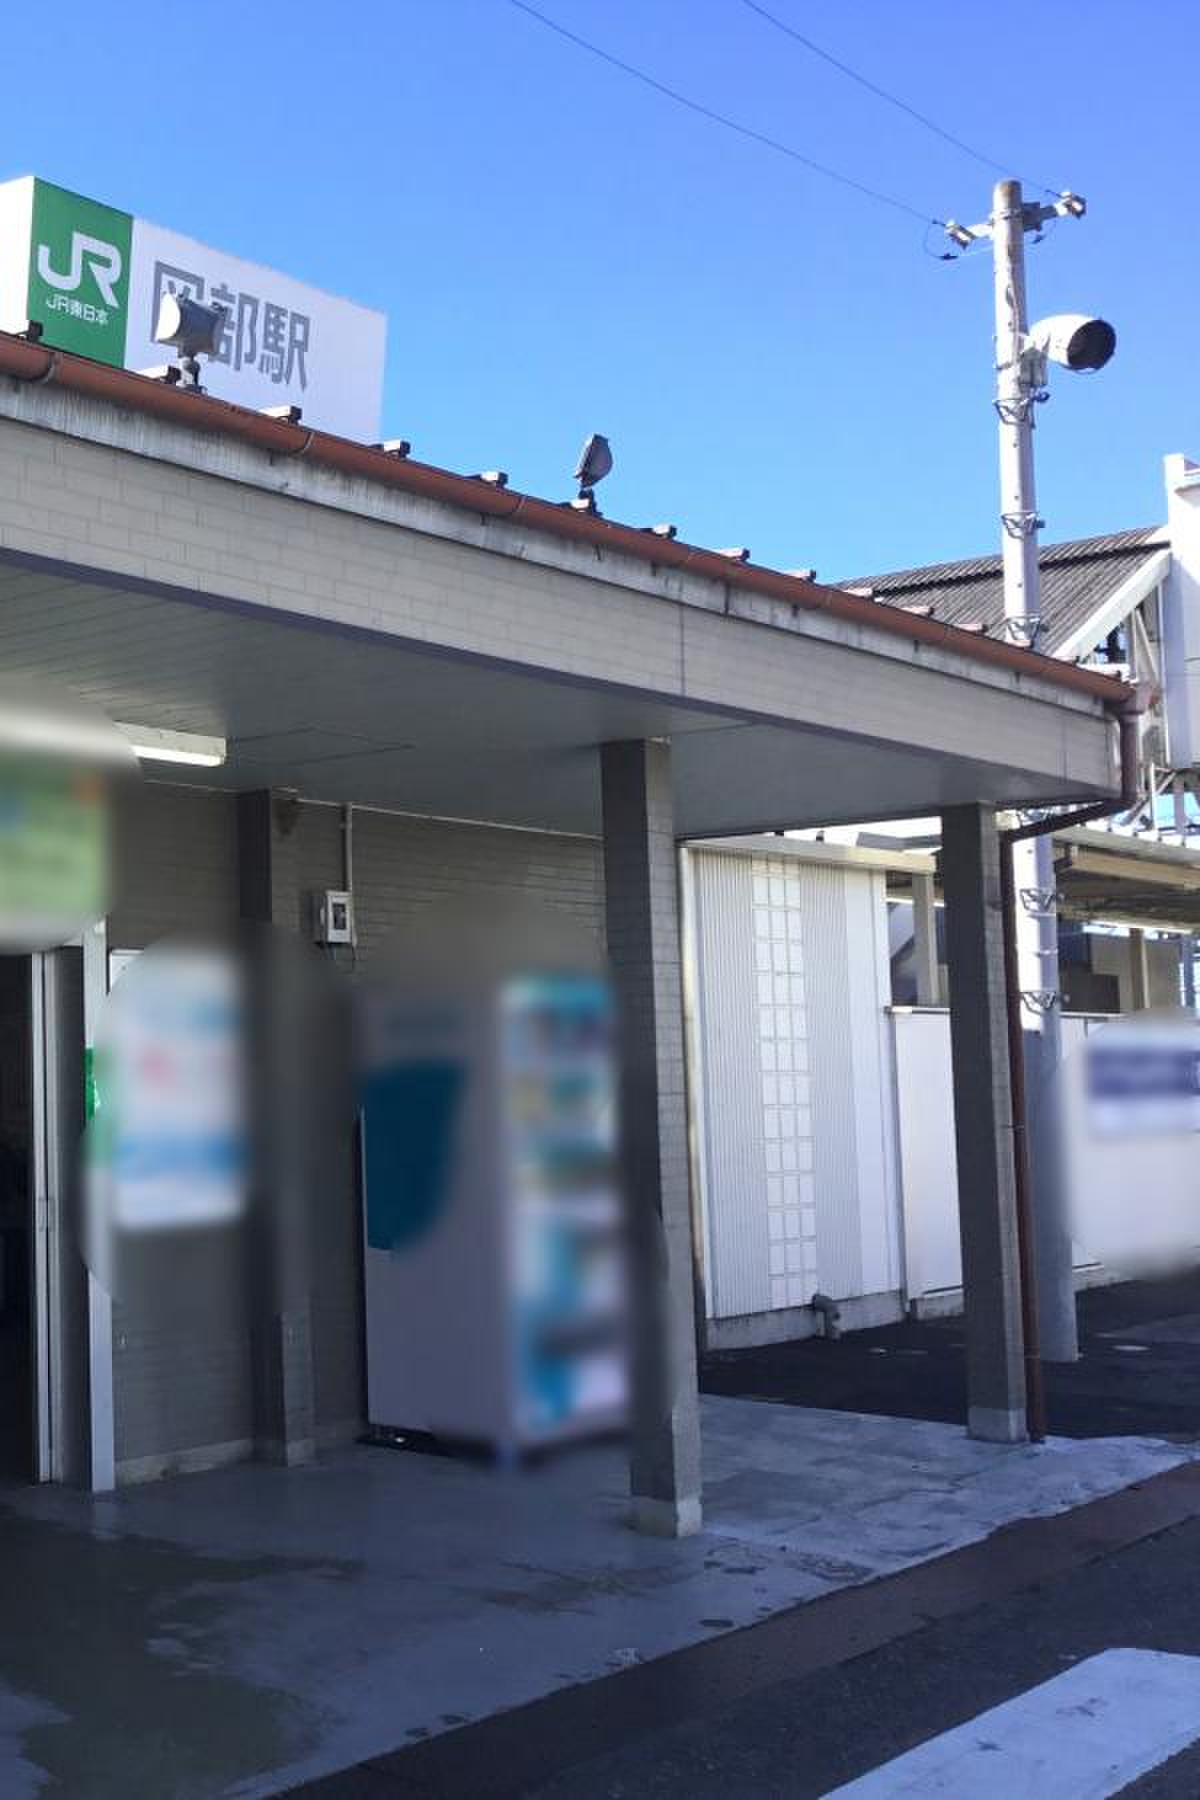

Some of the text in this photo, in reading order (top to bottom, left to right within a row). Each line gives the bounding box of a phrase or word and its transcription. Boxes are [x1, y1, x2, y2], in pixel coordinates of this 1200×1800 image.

[38, 231, 122, 309] JR
[46, 293, 108, 325] JR東日本
